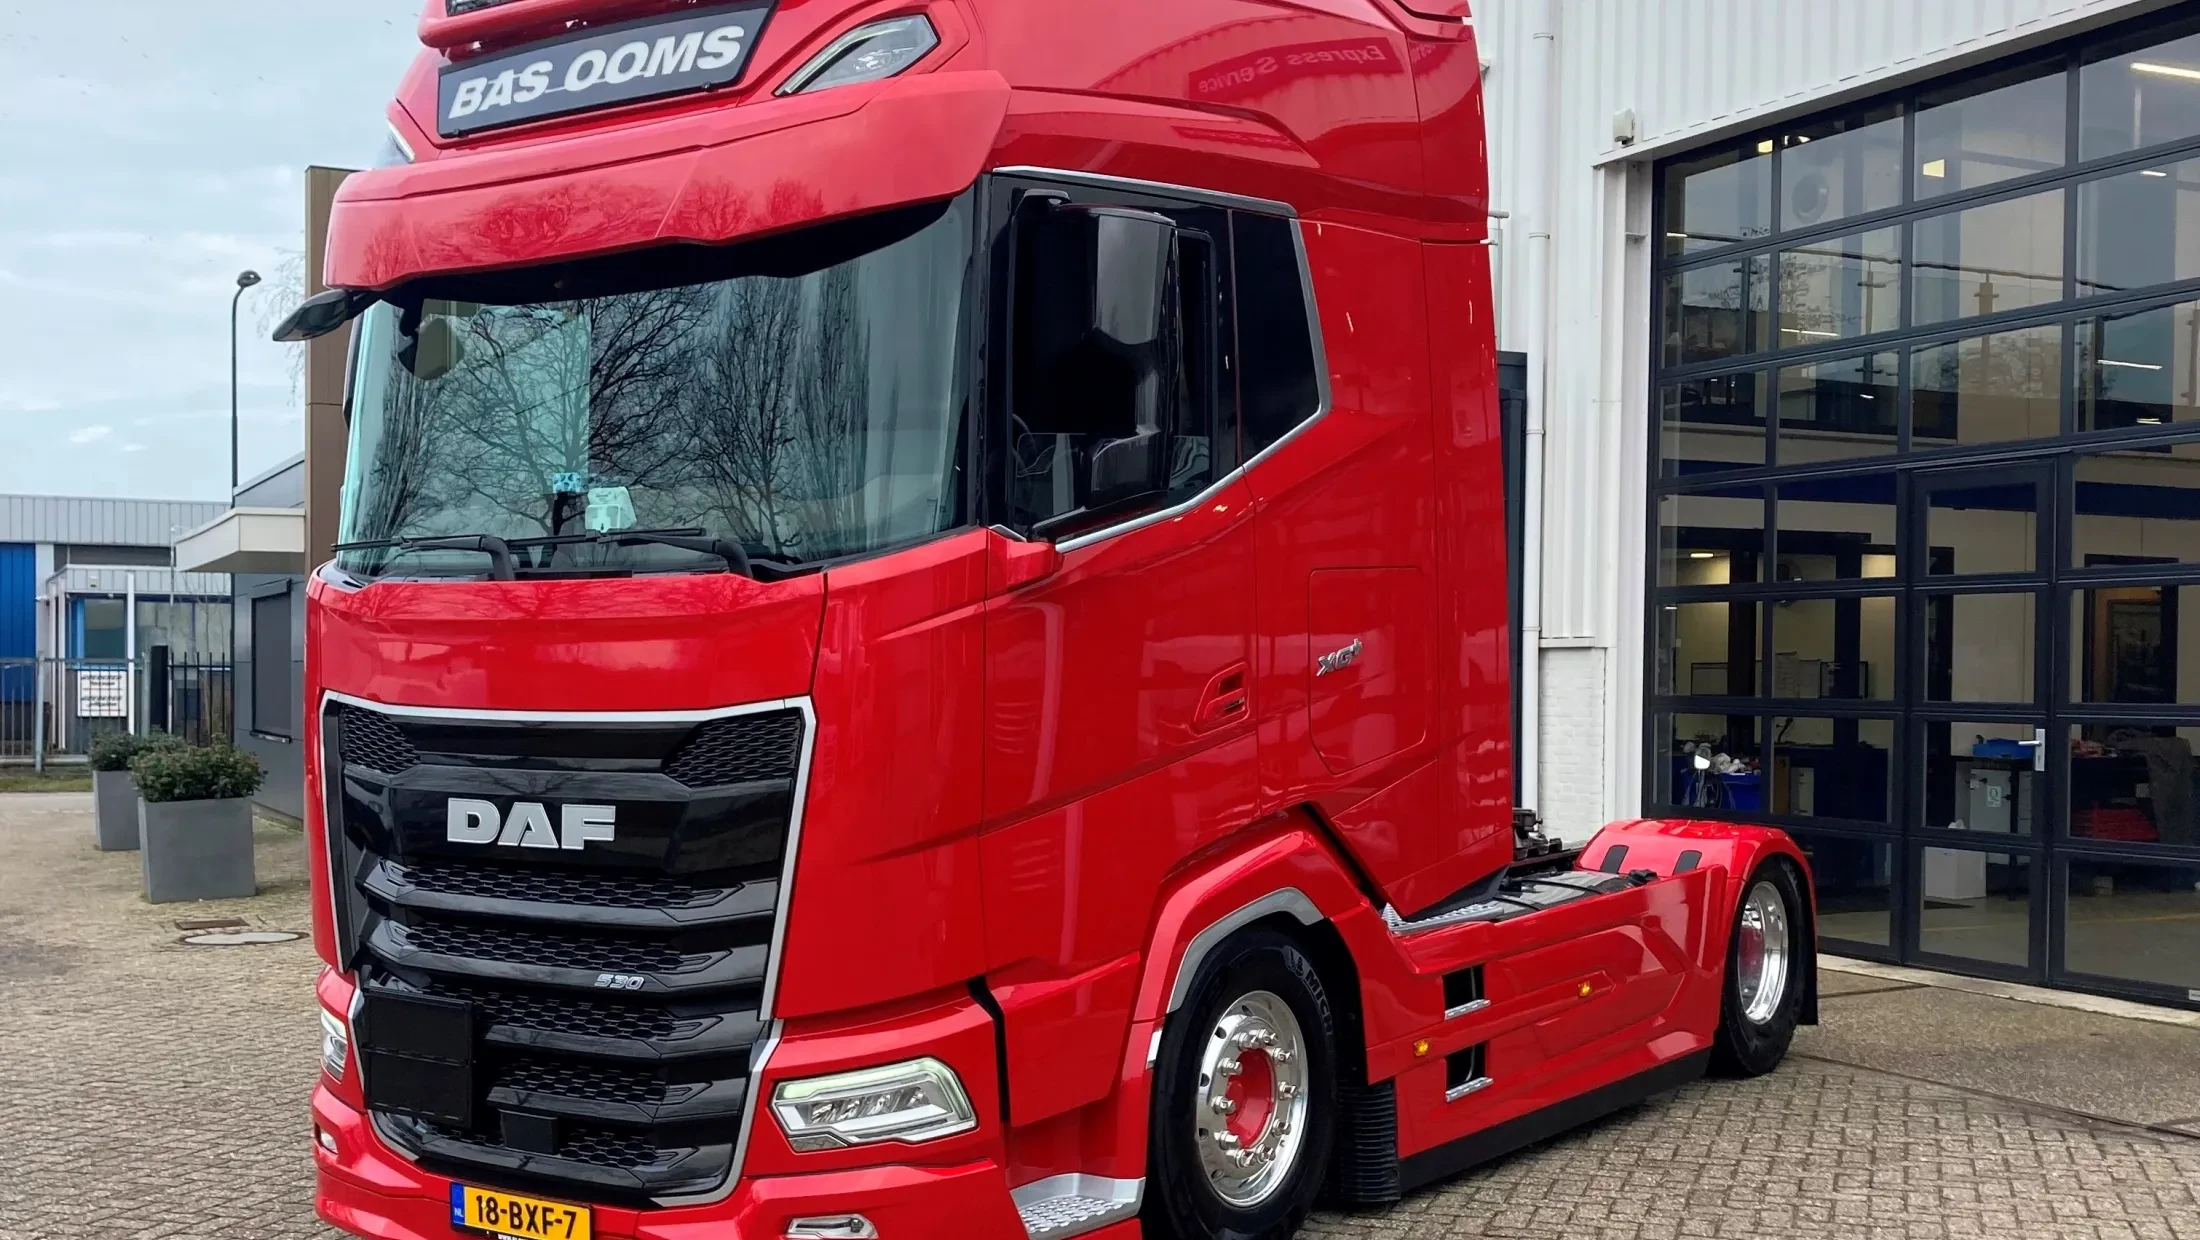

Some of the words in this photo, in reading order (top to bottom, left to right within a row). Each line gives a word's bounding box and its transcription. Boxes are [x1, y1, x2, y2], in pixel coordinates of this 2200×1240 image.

[448, 60, 553, 118] BAS
[563, 25, 745, 92] OOMS
[447, 797, 616, 850] DAF
[594, 973, 645, 989] 530
[454, 1207, 464, 1218] NL
[476, 1195, 577, 1239] 18-BXF-7
